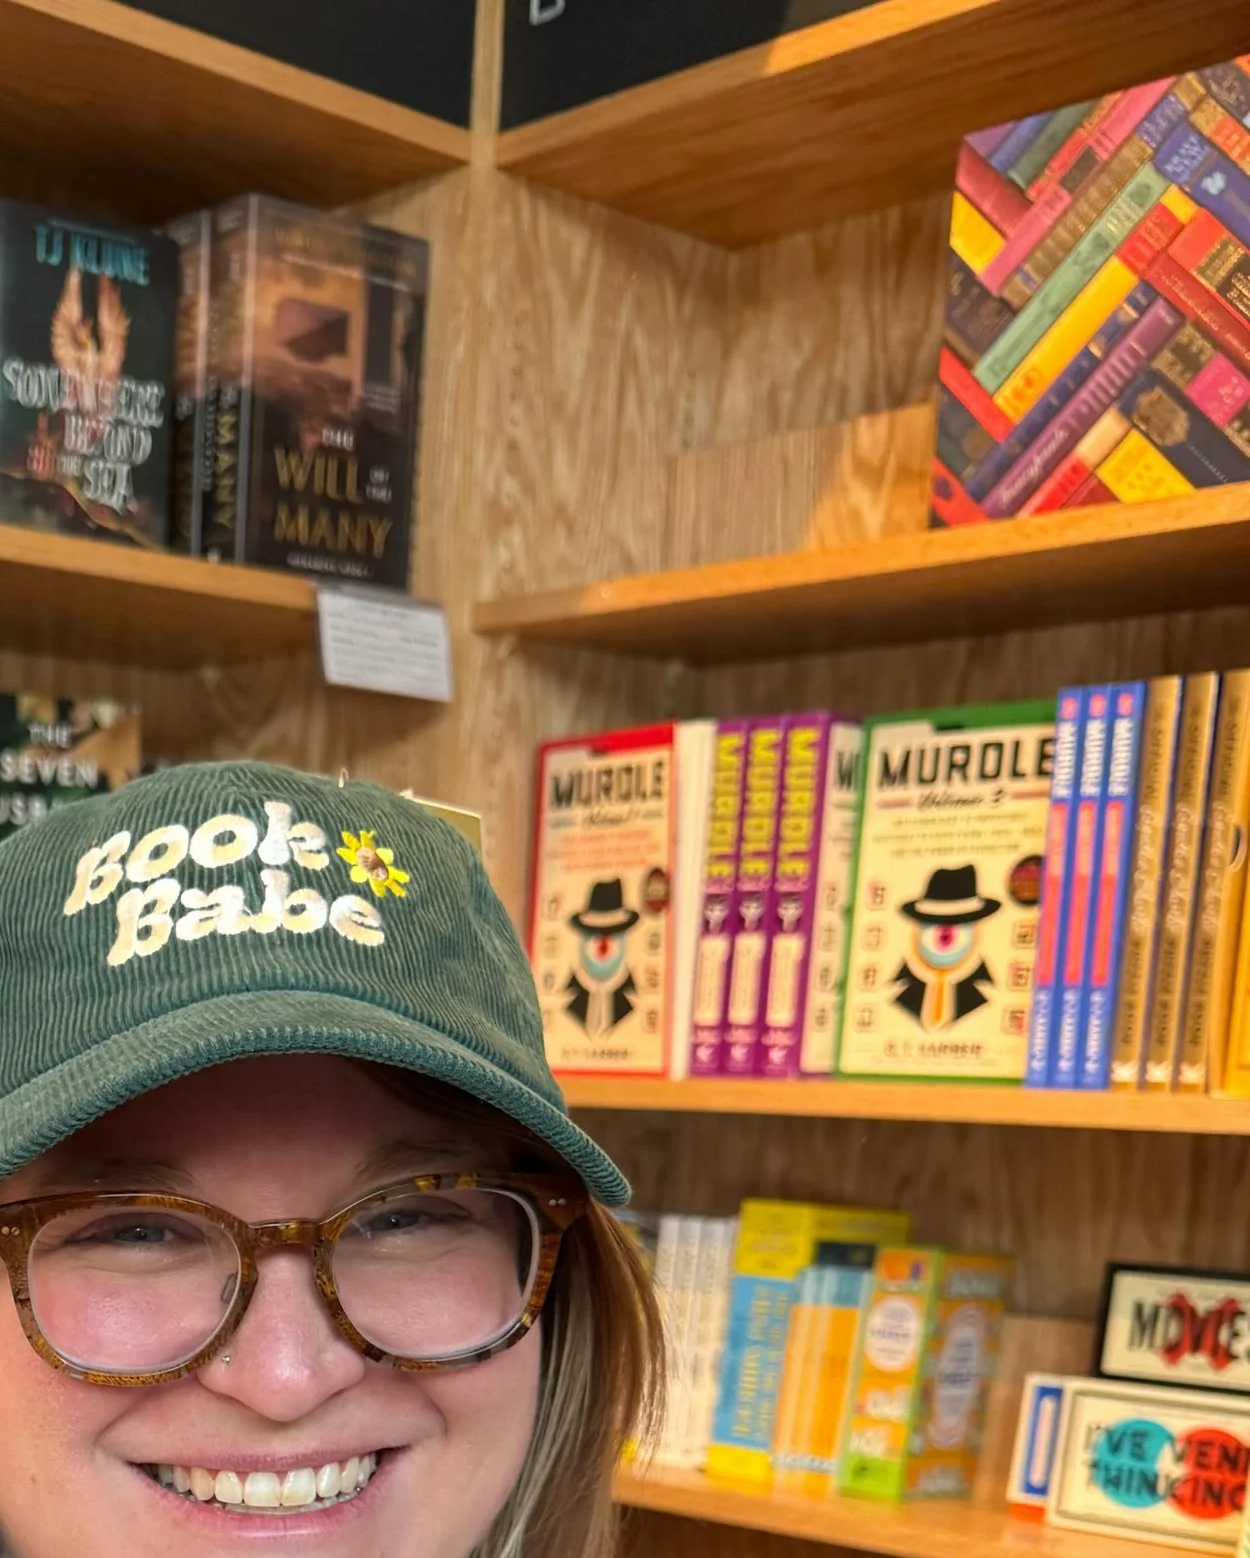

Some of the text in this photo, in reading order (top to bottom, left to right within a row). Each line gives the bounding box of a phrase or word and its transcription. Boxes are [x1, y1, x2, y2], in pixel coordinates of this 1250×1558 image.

[69, 230, 149, 286] KLUNE
[273, 445, 363, 504] WILL
[273, 505, 394, 560] MANY
[550, 758, 665, 810] MURDLE
[779, 727, 819, 877] MURDLE
[877, 735, 1054, 789] MURDLE
[706, 733, 745, 878] MURDLE
[742, 729, 781, 878] MURDLE
[62, 800, 330, 917] Book
[106, 867, 386, 968] Babe
